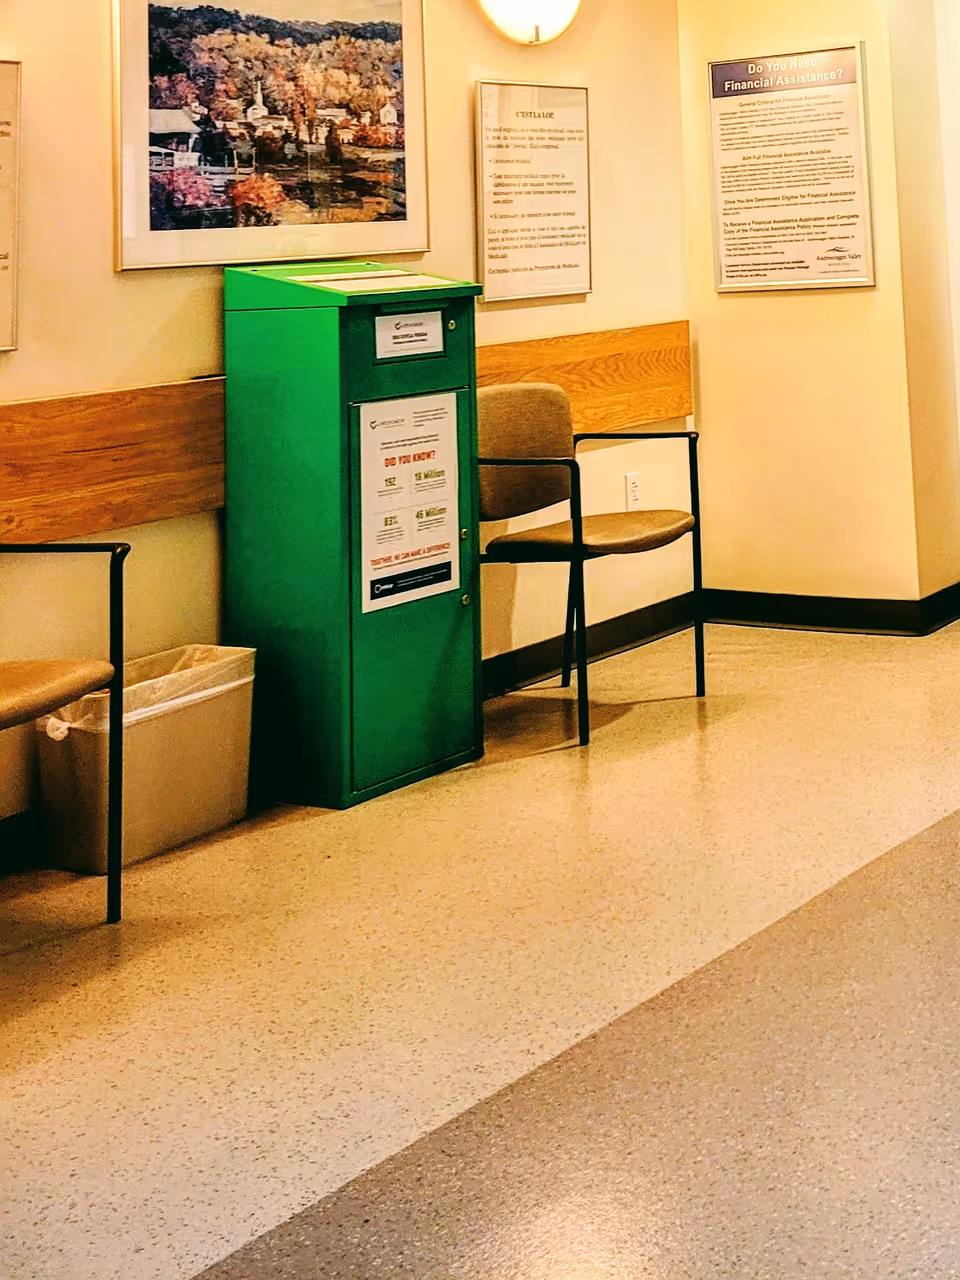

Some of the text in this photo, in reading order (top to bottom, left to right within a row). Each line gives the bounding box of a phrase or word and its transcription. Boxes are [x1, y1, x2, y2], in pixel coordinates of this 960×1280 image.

[748, 62, 763, 74] Do
[766, 60, 786, 73] You
[724, 69, 843, 92] Financial Assistance?
